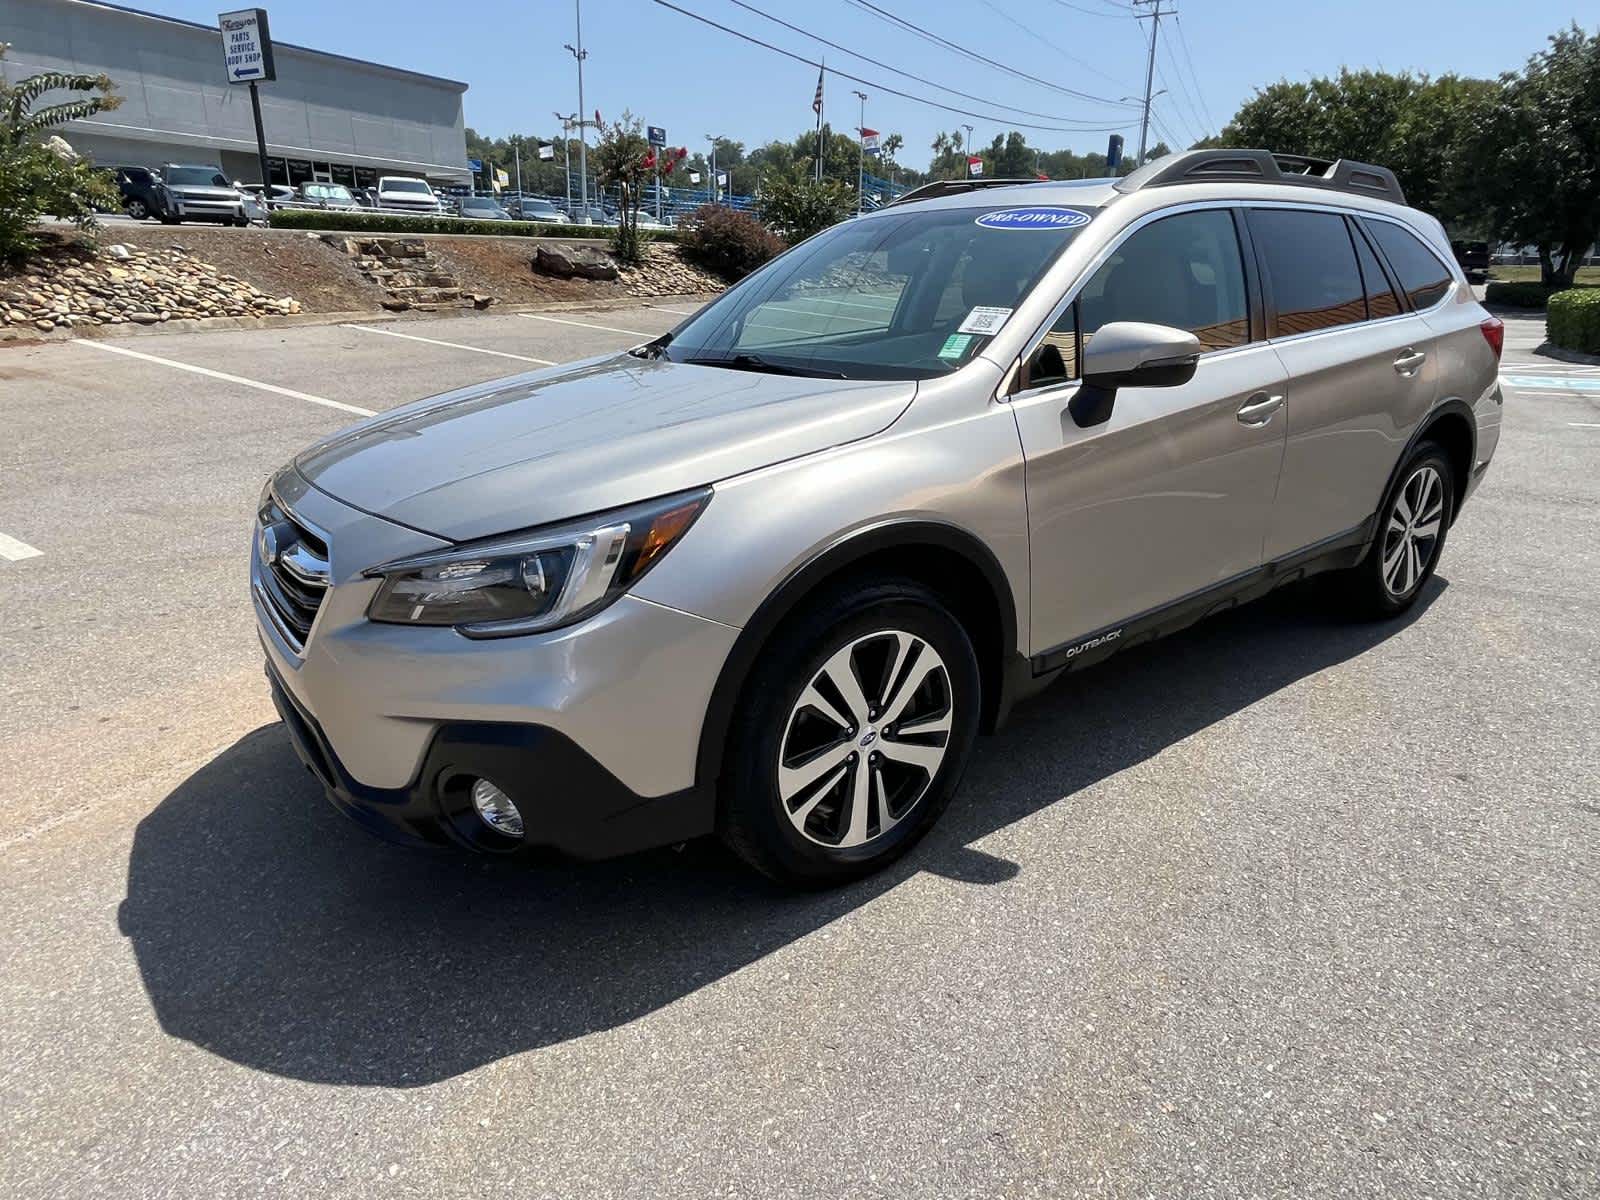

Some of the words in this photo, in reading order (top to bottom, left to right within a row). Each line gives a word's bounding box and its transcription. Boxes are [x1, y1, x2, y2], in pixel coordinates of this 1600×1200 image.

[231, 32, 250, 42] PARTS
[230, 42, 256, 54] SERVICE
[228, 55, 243, 65] BODY
[244, 53, 261, 63] SHOP
[980, 213, 1087, 225] PRE-OWNED
[1066, 629, 1122, 658] OUTBACK
